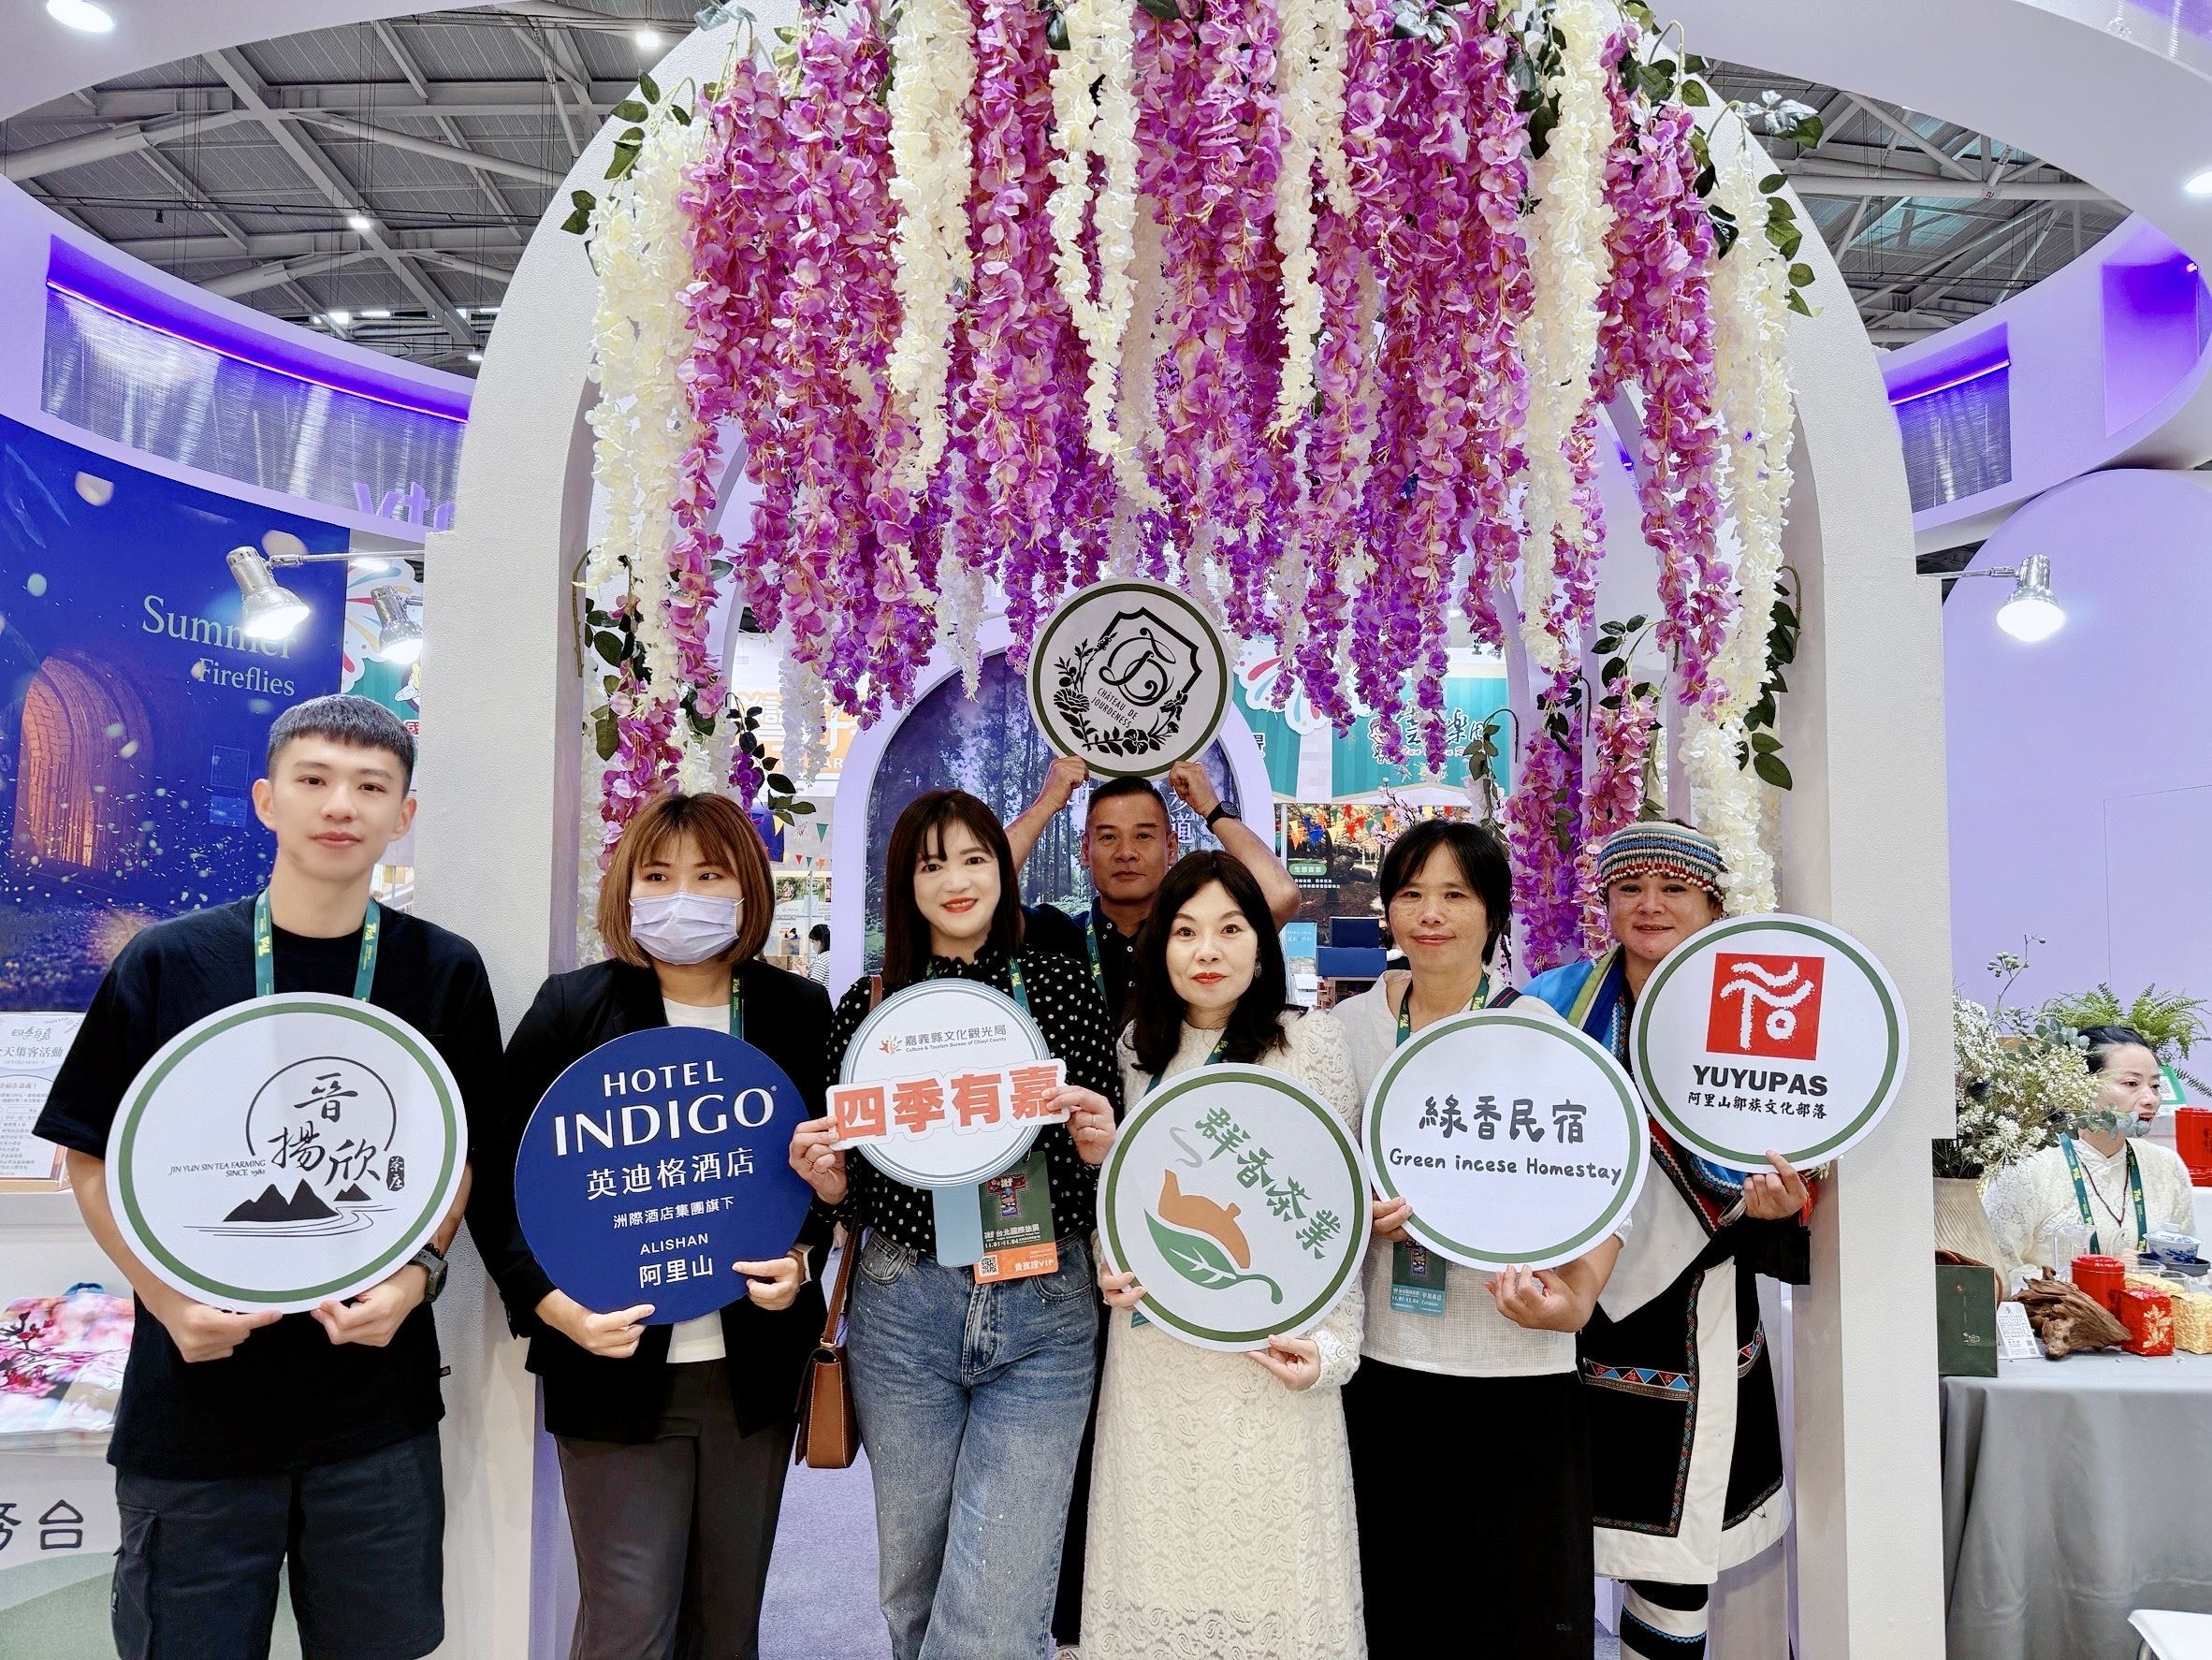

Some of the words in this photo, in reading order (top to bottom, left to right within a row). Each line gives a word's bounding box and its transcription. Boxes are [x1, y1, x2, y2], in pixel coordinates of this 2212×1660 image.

[197, 657, 296, 696] Fireflies
[1128, 708, 1139, 721] DE
[0, 1046, 64, 1057] 天集客活動
[904, 1025, 1007, 1047] 嘉義縣文化觀光局
[604, 1060, 723, 1098] HOTEL
[1693, 1065, 1828, 1098] YUYUPAS
[833, 1065, 1063, 1142] 四季有嘉
[1419, 1094, 1588, 1144] 綠香民宿
[1688, 1091, 1827, 1120] 阿里山鄒族文化部落
[554, 1087, 775, 1157] INDIGO
[168, 1165, 182, 1176] JIN
[182, 1164, 200, 1172] YUN
[230, 1159, 267, 1168] FARMING
[226, 1169, 249, 1177] SINCE
[586, 1146, 754, 1201] 英迪格酒店
[1390, 1147, 1446, 1169] Green
[1455, 1155, 1517, 1173] incese
[1526, 1158, 1622, 1187] Homestay
[613, 1195, 735, 1230] 洲際酒店集團旗下
[640, 1232, 709, 1256] ALISHAN
[639, 1254, 714, 1289] 阿里山
